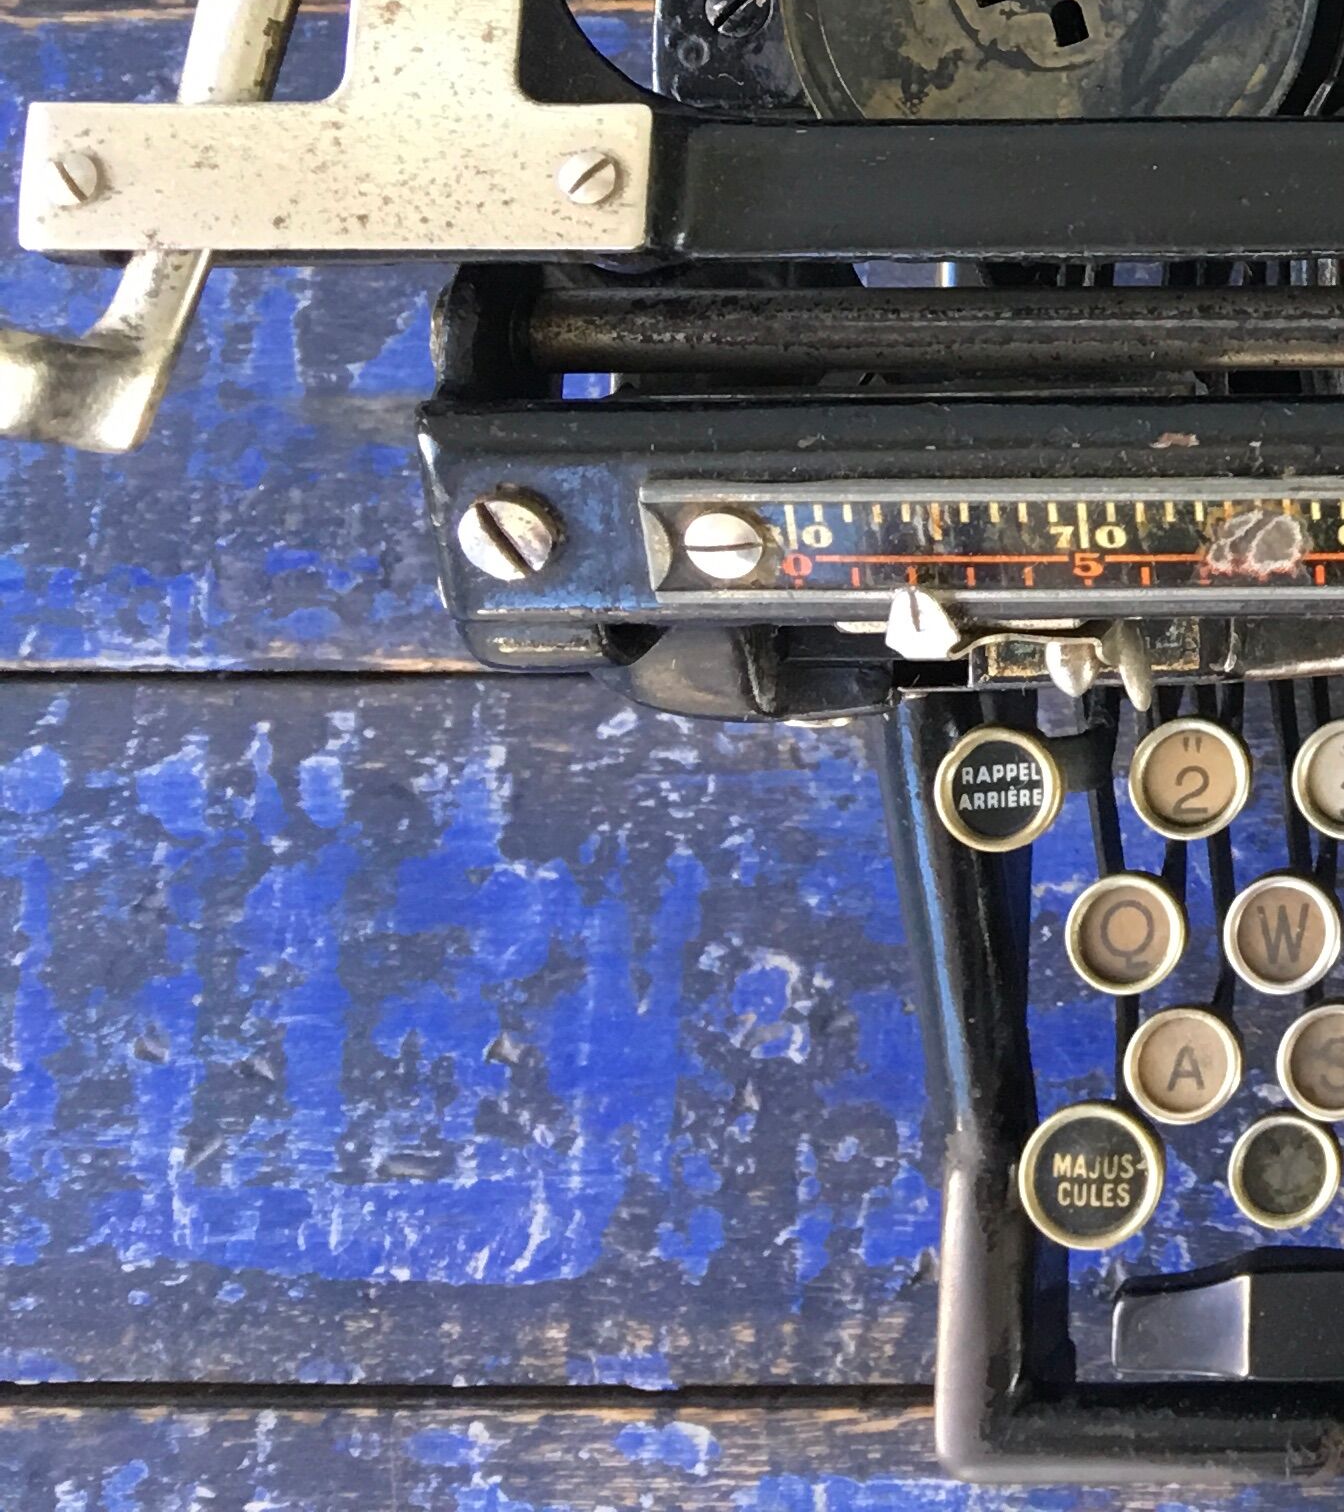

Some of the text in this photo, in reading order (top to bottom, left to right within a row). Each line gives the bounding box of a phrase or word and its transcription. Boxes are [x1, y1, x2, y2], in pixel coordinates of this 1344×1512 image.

[1071, 554, 1102, 578] 5
[962, 763, 1041, 785] RAPPEL
[959, 786, 1042, 811] ARRIÈRE
[1173, 765, 1208, 816] 2
[1257, 903, 1309, 964] W
[1167, 1044, 1206, 1091] A
[1056, 1182, 1131, 1209] CULES
